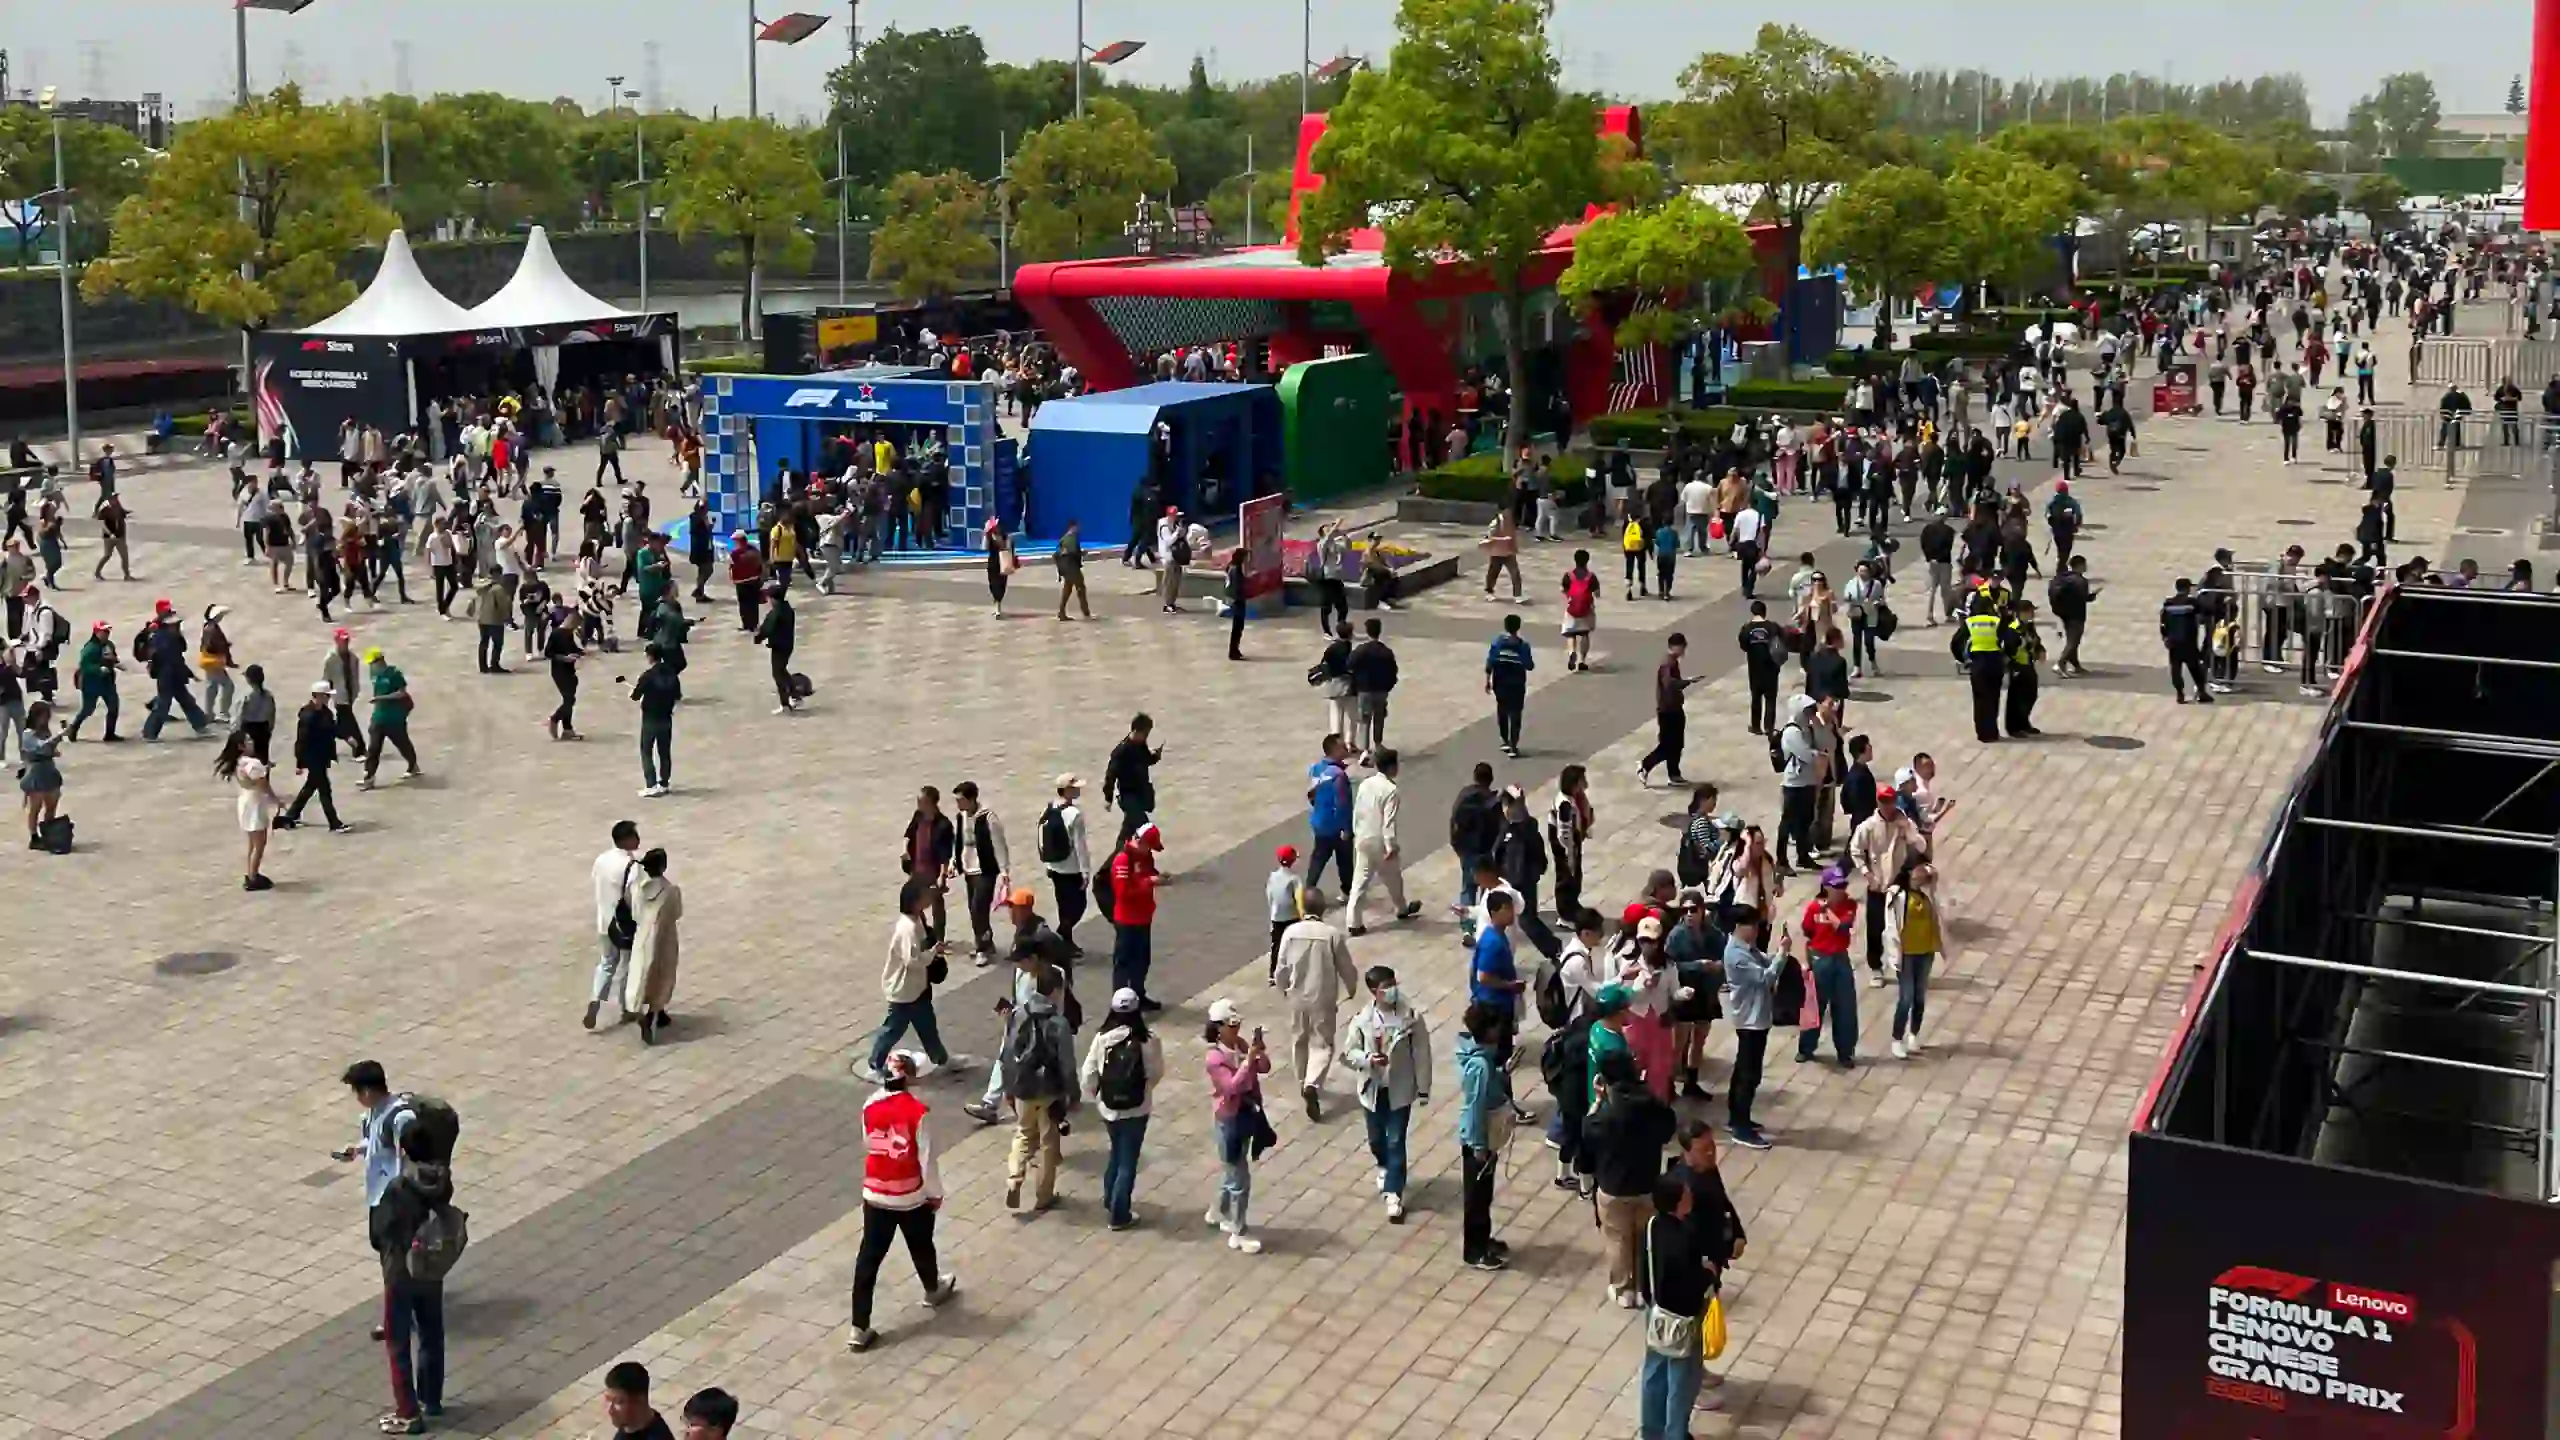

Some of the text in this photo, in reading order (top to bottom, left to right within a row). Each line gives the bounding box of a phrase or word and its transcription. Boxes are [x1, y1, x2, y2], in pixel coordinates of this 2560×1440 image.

[327, 340, 354, 352] Store
[2208, 1286, 2393, 1343] FORMULA 1
[2335, 1287, 2408, 1315] Lenovo
[2208, 1309, 2334, 1352] LENOVO
[2208, 1333, 2339, 1377] CHINESE
[2207, 1355, 2405, 1413] GRAND PRIX
